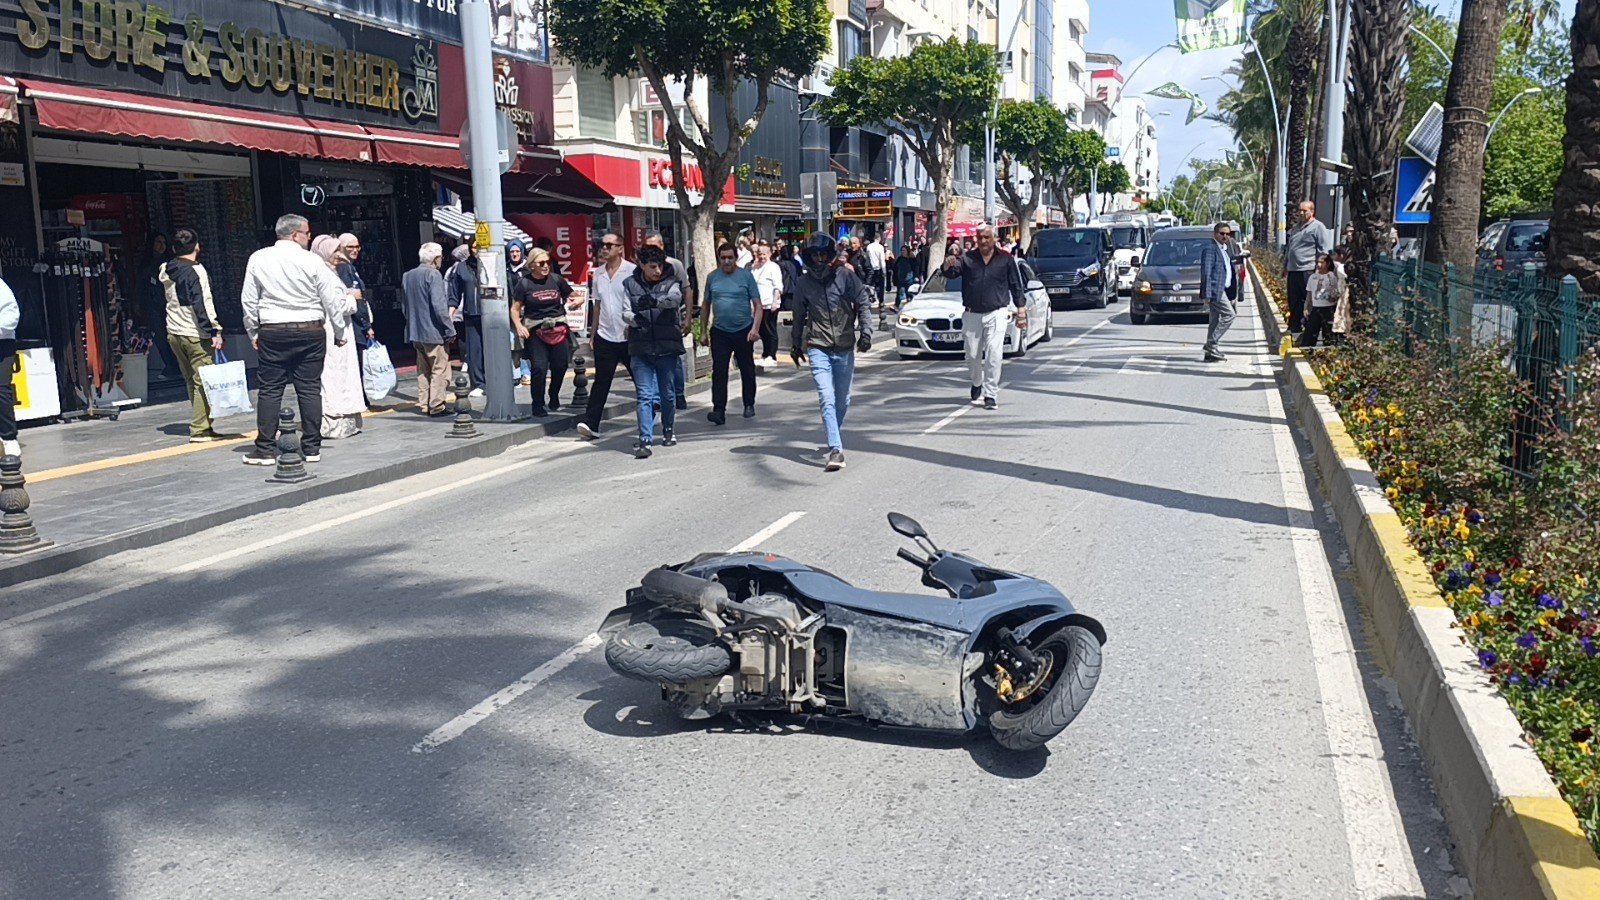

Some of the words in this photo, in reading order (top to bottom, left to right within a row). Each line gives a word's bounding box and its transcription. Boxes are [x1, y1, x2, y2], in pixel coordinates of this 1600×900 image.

[16, 0, 172, 73] STORE
[182, 12, 212, 78] &
[218, 20, 401, 112] SOUVENIER
